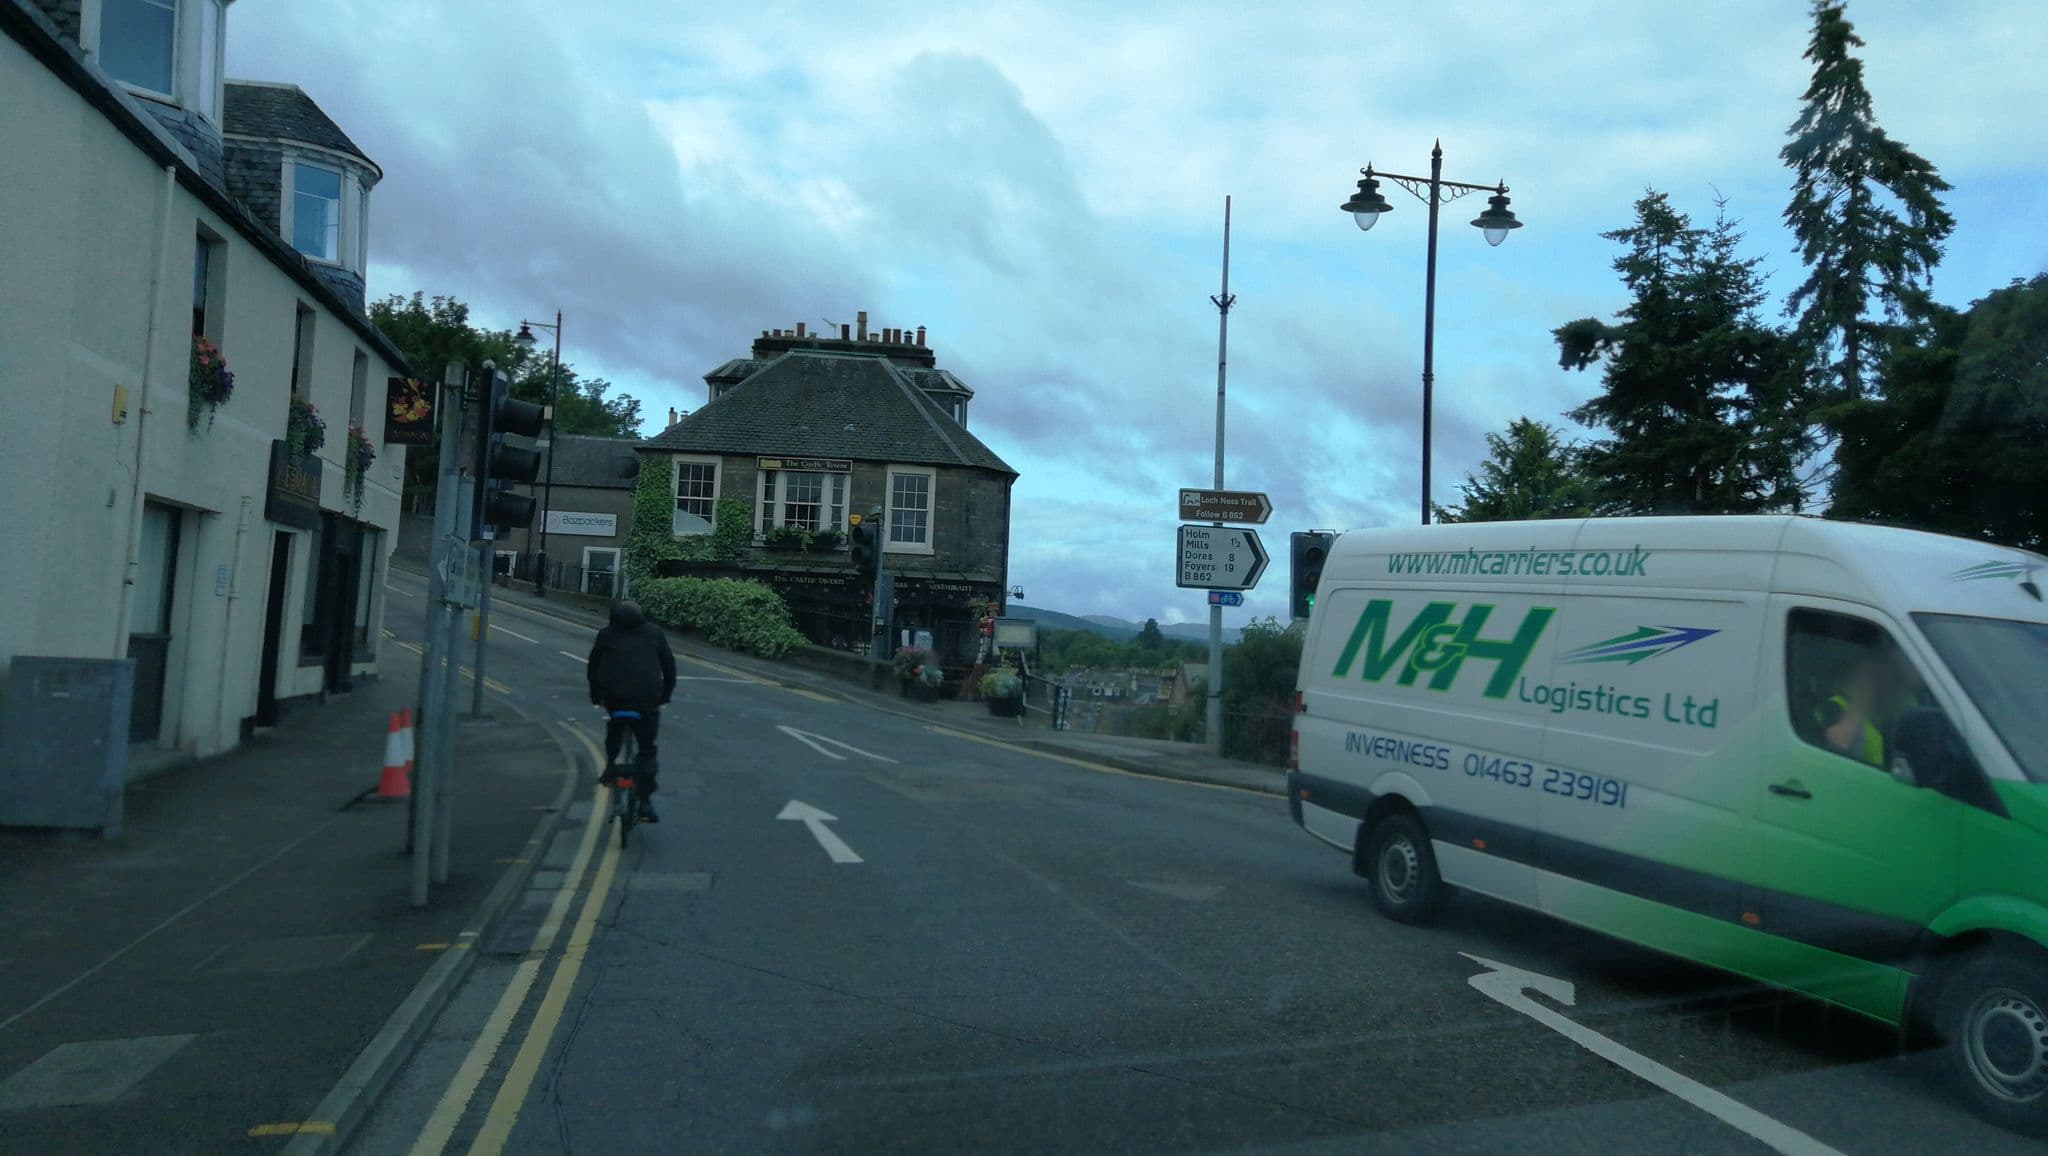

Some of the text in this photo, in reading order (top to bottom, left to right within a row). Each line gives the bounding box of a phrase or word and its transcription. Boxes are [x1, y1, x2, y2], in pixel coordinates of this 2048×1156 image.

[1201, 496, 1257, 506] Loch Ness Trail
[1196, 509, 1220, 518] Follow
[1185, 529, 1210, 539] Holm
[1186, 540, 1209, 549] Mills
[1185, 551, 1235, 562] Dores 8
[1388, 544, 1652, 577] www.mhcarriers.co.uk
[1184, 561, 1235, 572] Foyers 19
[1331, 599, 1558, 700] M&H
[1519, 676, 1720, 729] Logistics Ltd
[1345, 731, 1627, 809] INVERNESS 01463 239191
